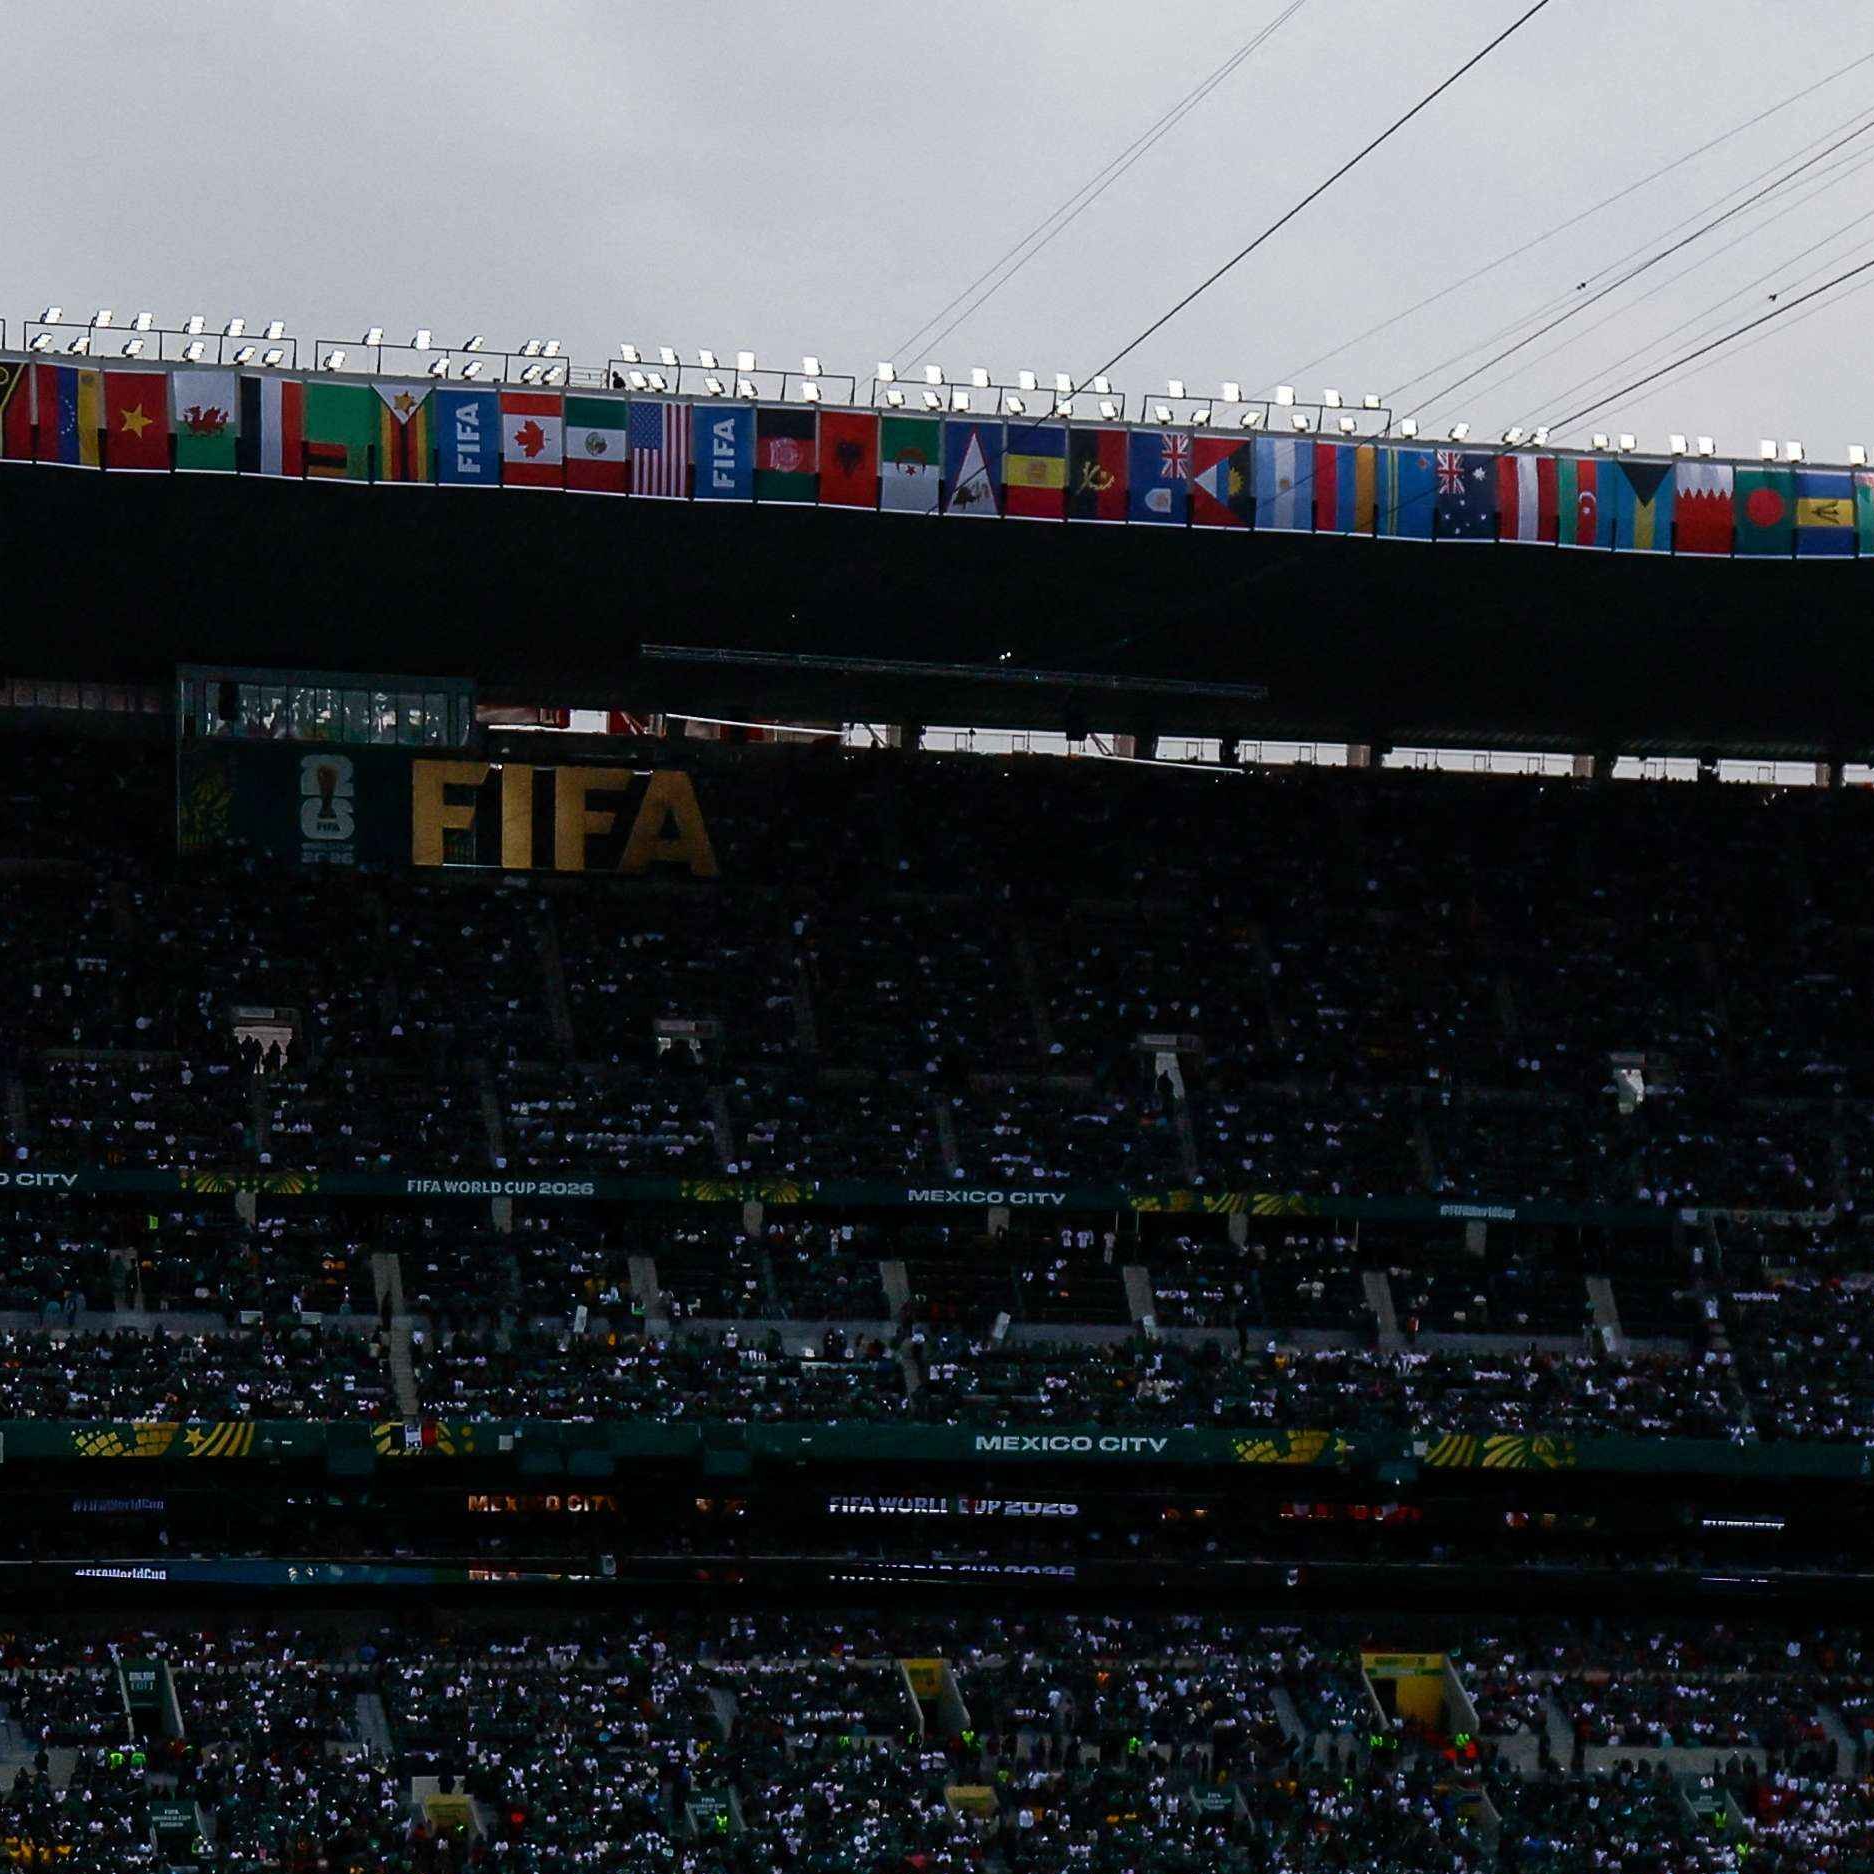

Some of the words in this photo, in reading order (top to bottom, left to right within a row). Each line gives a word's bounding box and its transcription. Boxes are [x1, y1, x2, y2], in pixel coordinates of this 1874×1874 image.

[455, 402, 480, 474] FIFA
[712, 417, 736, 489] FIFA
[411, 759, 721, 877] FIFA
[15, 1172, 78, 1187] CITY
[406, 1179, 442, 1194] FIFA
[444, 1180, 502, 1195] WORLD
[504, 1181, 537, 1195] CUP
[539, 1182, 596, 1196] 2026
[907, 1189, 1005, 1204] MEXICO
[1009, 1191, 1067, 1205] CITY
[975, 1435, 1094, 1452] MEXICO
[1097, 1436, 1169, 1453] CITY
[828, 1496, 876, 1515] FIFA
[1004, 1500, 1079, 1516] 2026
